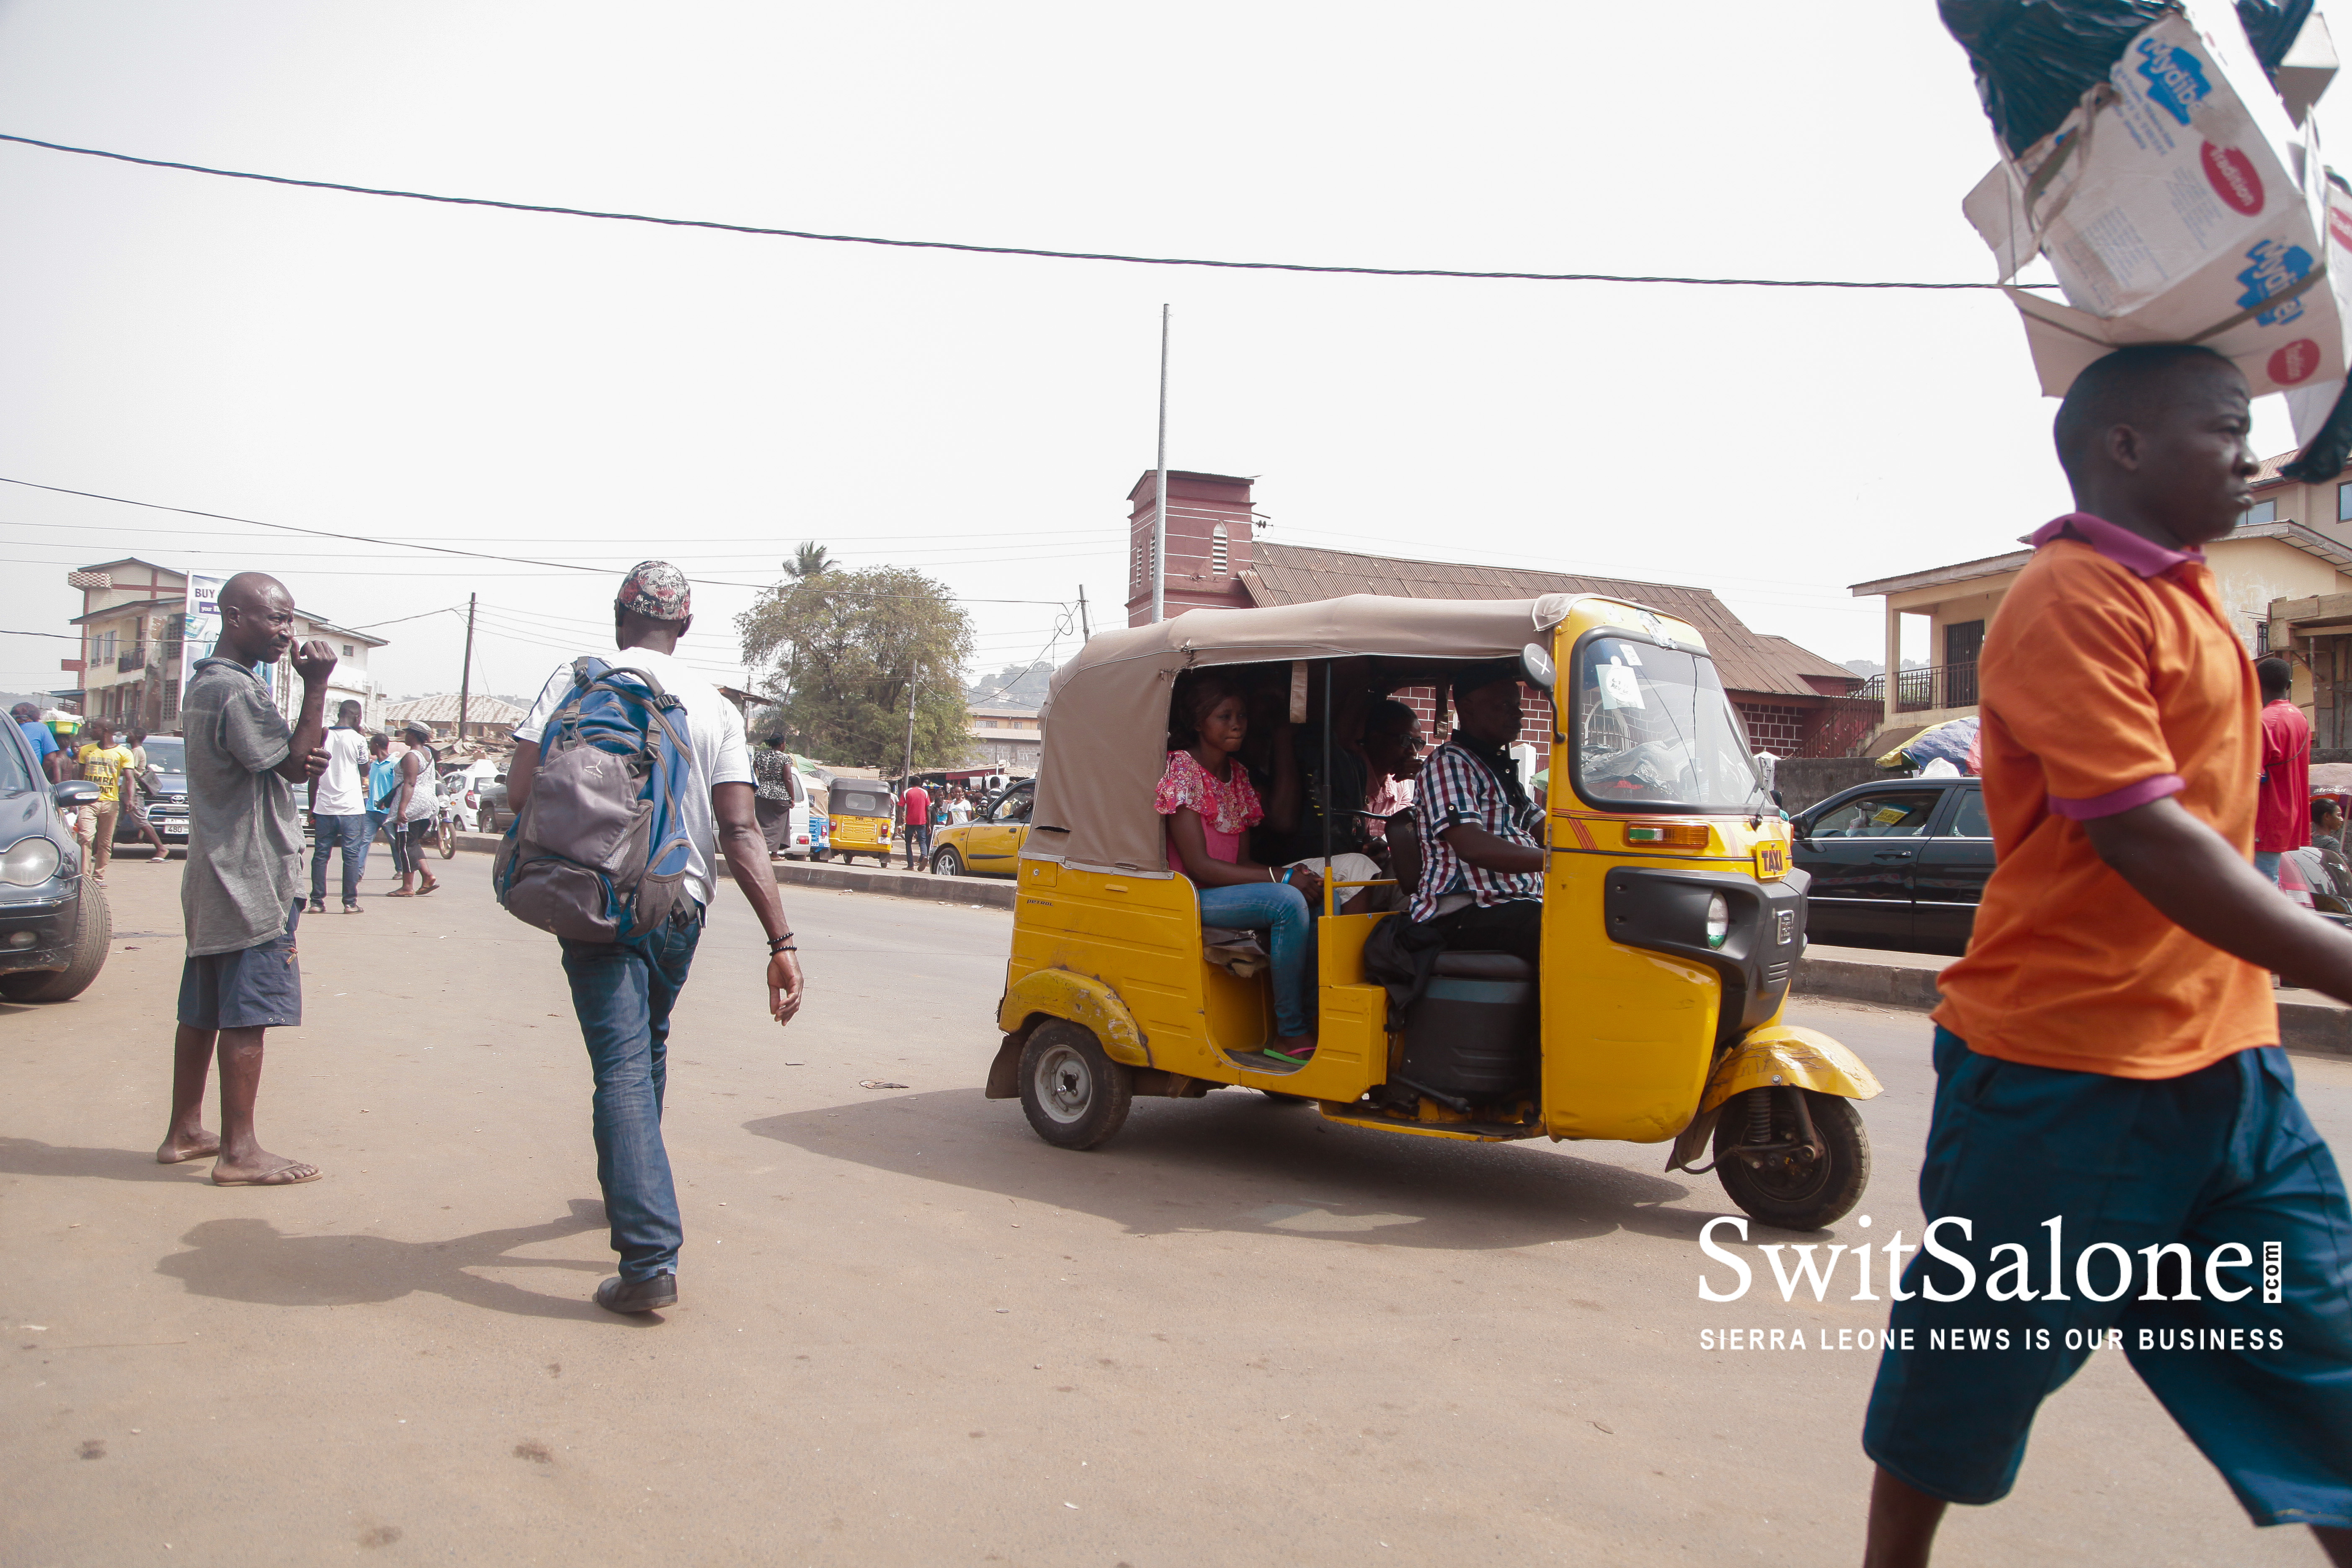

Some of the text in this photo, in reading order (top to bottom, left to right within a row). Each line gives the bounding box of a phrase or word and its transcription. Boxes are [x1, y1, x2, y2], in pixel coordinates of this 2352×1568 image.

[2143, 37, 2209, 108] Mydibe
[2252, 237, 2306, 325] Mydiel
[195, 588, 215, 598] BUY
[1761, 850, 1783, 872] TAXI
